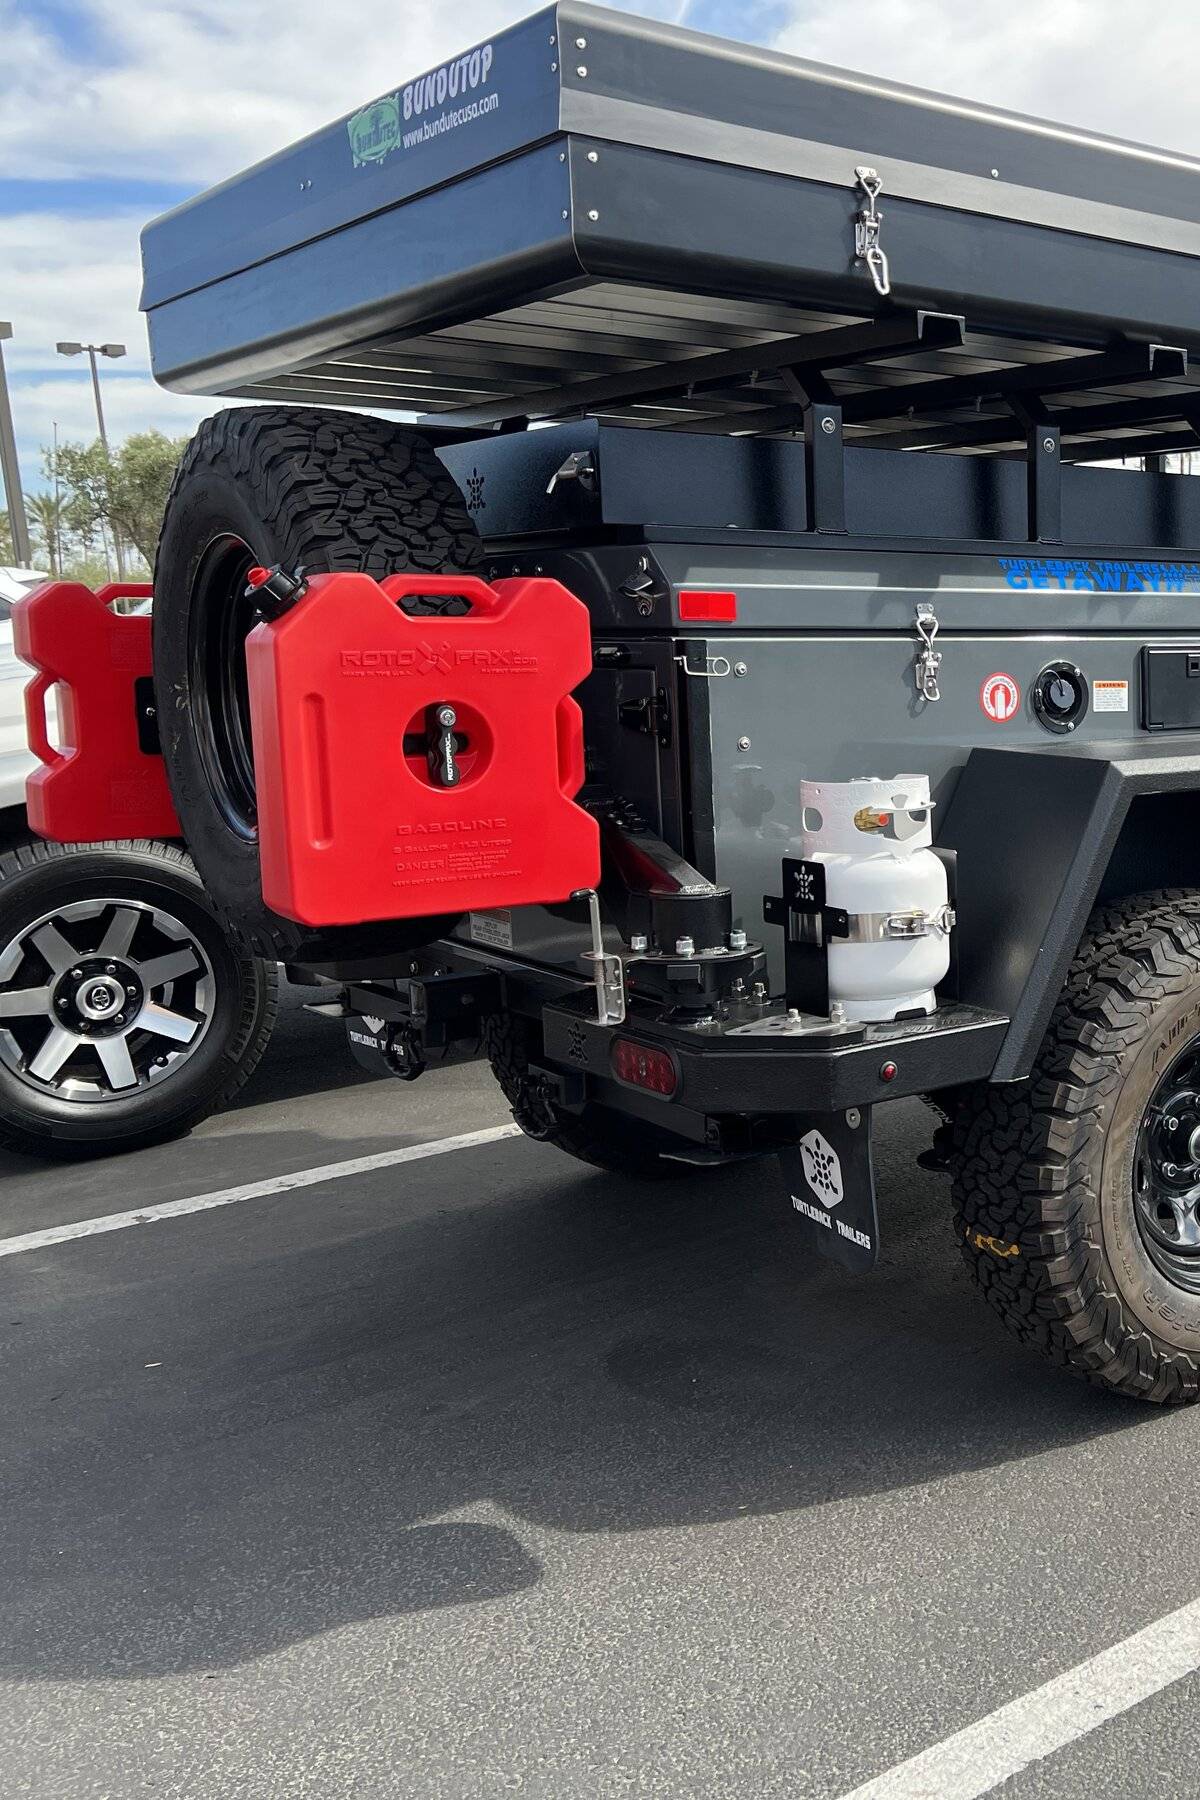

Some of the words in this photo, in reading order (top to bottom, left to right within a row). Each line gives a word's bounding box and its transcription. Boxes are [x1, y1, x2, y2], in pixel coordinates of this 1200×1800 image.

[402, 44, 493, 121] BUNDUTOP
[402, 92, 499, 149] www.bundutecusa.com
[998, 558, 1090, 573] TURTLEBACK
[1097, 561, 1160, 574] TRAILERS
[1006, 570, 1162, 593] GETAWAY
[396, 818, 507, 836] GASOLINE
[791, 1194, 833, 1230] TURTLEBACK
[836, 1219, 872, 1250] TRAILERS
